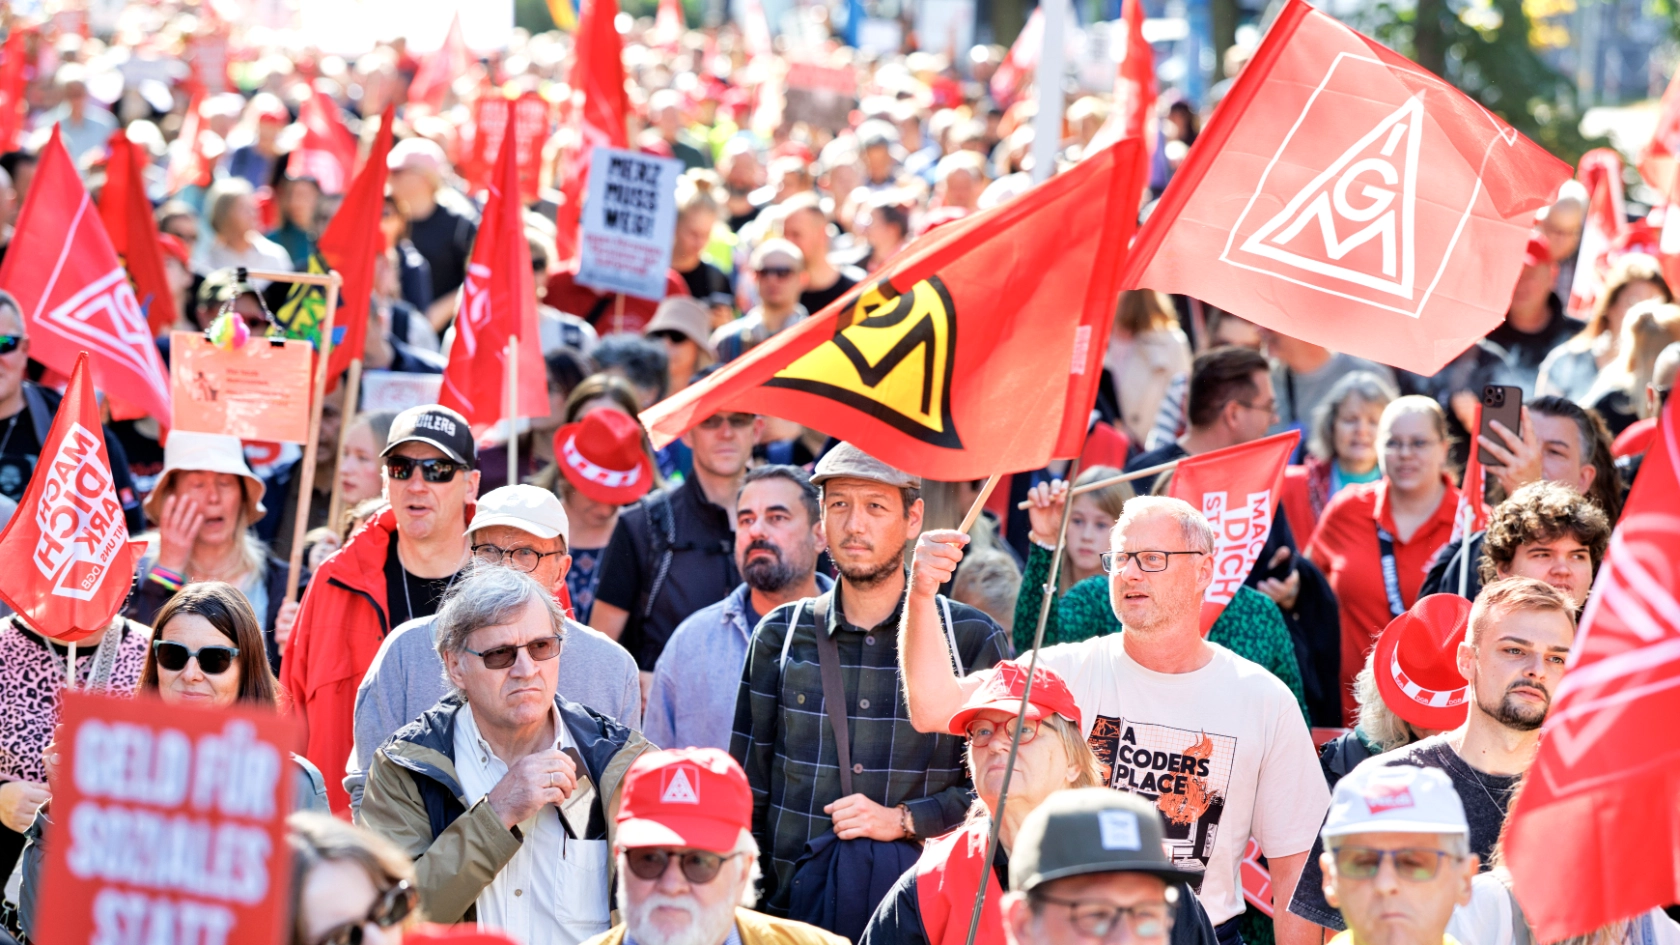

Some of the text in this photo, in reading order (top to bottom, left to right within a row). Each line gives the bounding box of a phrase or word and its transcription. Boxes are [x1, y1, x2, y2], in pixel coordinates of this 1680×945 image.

[608, 156, 663, 186] MERZ
[604, 182, 657, 211] MUSS
[1210, 517, 1250, 598] DICH
[1121, 726, 1137, 746] A
[75, 720, 279, 821] GELD FÜR
[1118, 745, 1210, 777] CODERS
[1115, 764, 1188, 795] PLACE
[67, 802, 271, 905] SOZIALES
